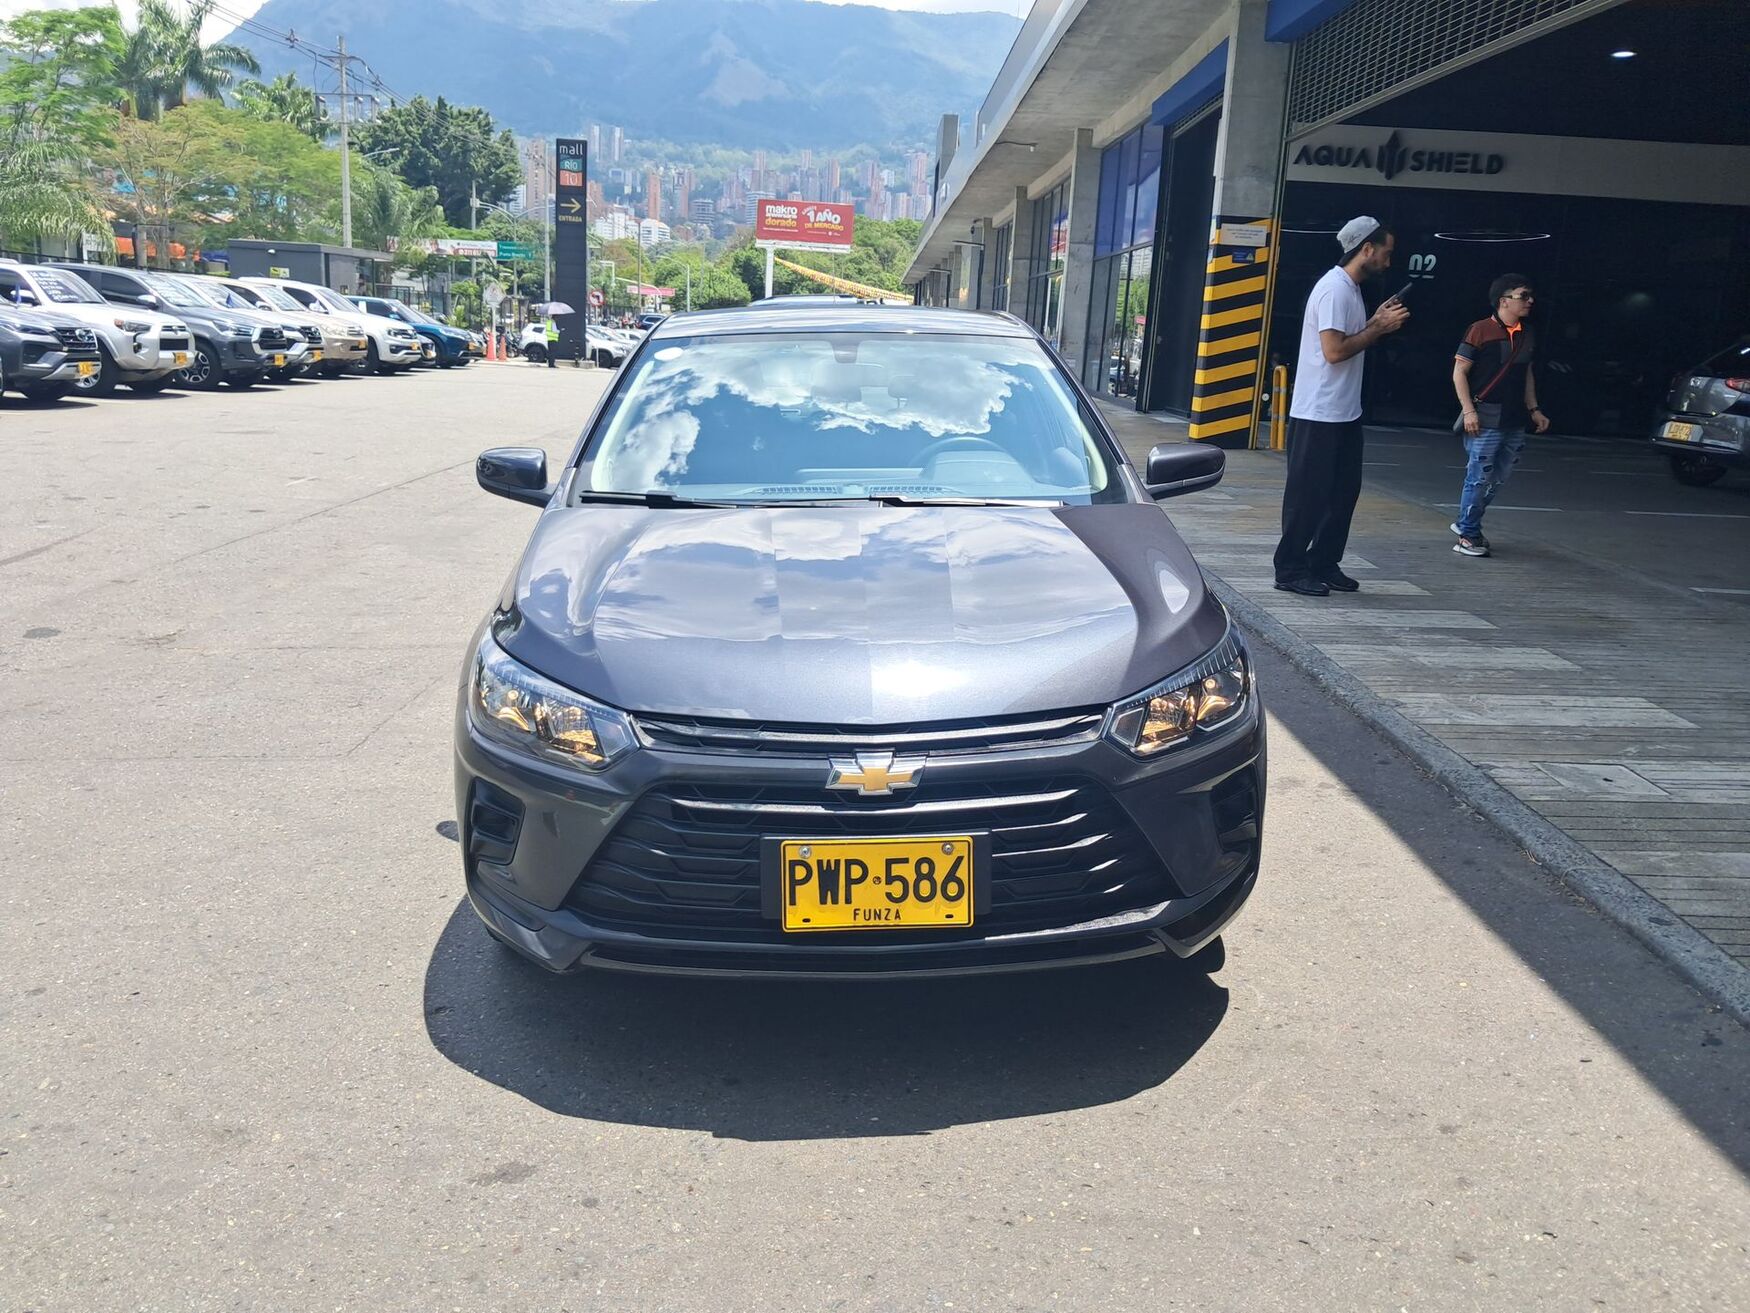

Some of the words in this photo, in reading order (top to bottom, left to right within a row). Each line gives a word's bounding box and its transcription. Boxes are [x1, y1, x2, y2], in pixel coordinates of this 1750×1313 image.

[560, 143, 583, 155] mall
[1293, 144, 1372, 169] AQUA
[1408, 150, 1504, 175] SHIELD
[565, 173, 578, 185] 10
[766, 204, 797, 214] makro
[807, 210, 815, 222] 1
[815, 208, 841, 224] AÑO
[766, 218, 796, 227] dorado
[813, 222, 844, 231] MERCADO
[1408, 253, 1437, 279] 02
[852, 907, 903, 921] FUNZA
